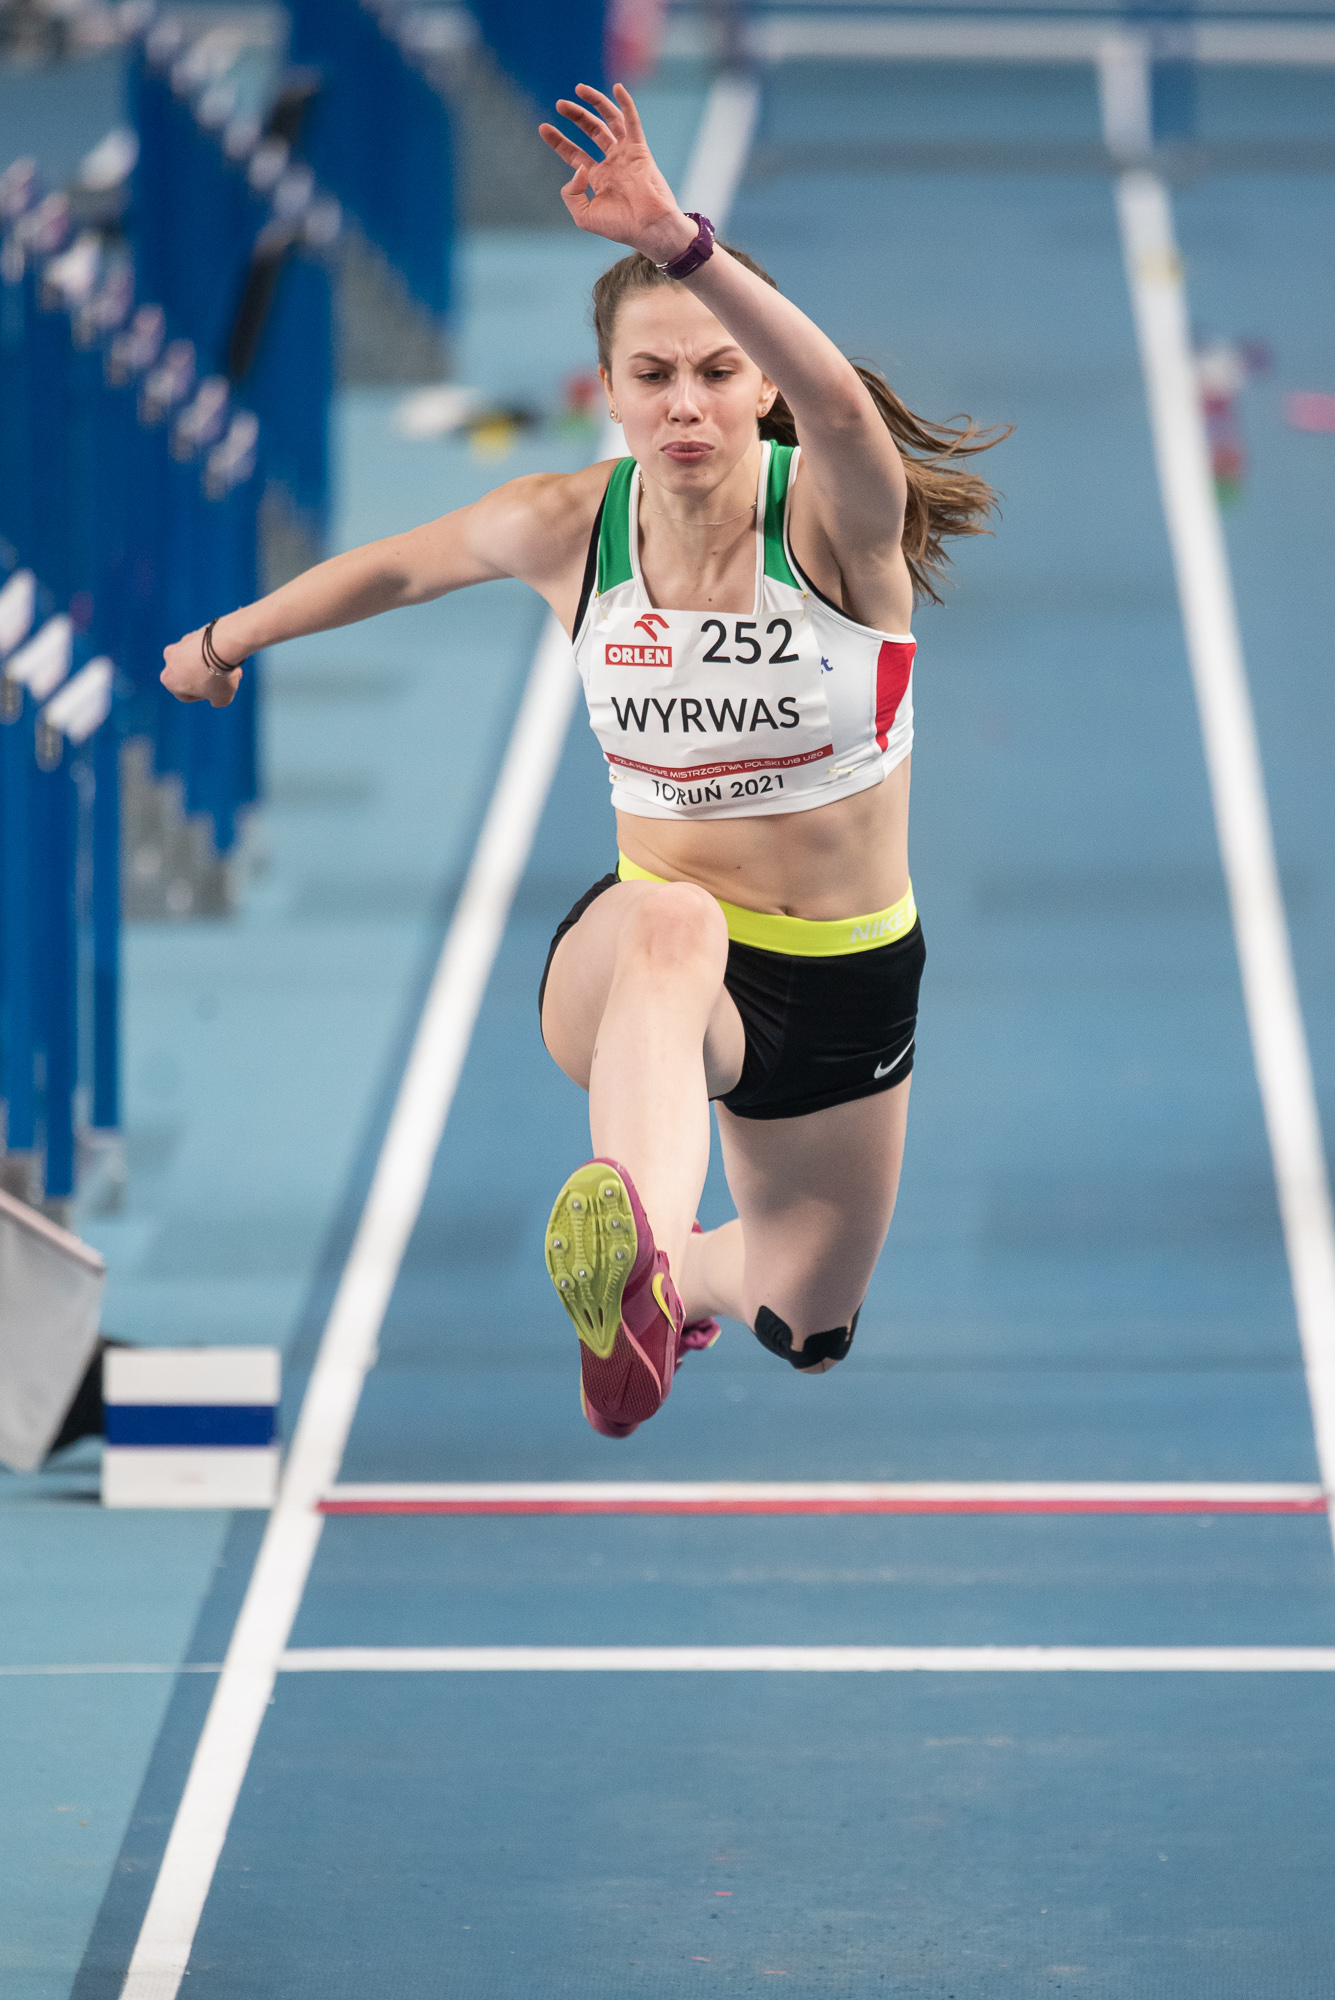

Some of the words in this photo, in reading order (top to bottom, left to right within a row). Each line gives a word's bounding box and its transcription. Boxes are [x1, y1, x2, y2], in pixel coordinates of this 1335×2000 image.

[608, 646, 669, 665] ORLEN
[700, 618, 799, 665] 252
[610, 696, 801, 734] WYRWAS
[669, 763, 743, 779] MISTRZOSTWA
[744, 760, 781, 769] POLSKI
[802, 751, 824, 762] U20
[651, 779, 723, 806] TORUŃ
[730, 774, 784, 798] 2021
[849, 907, 906, 943] NIKE
